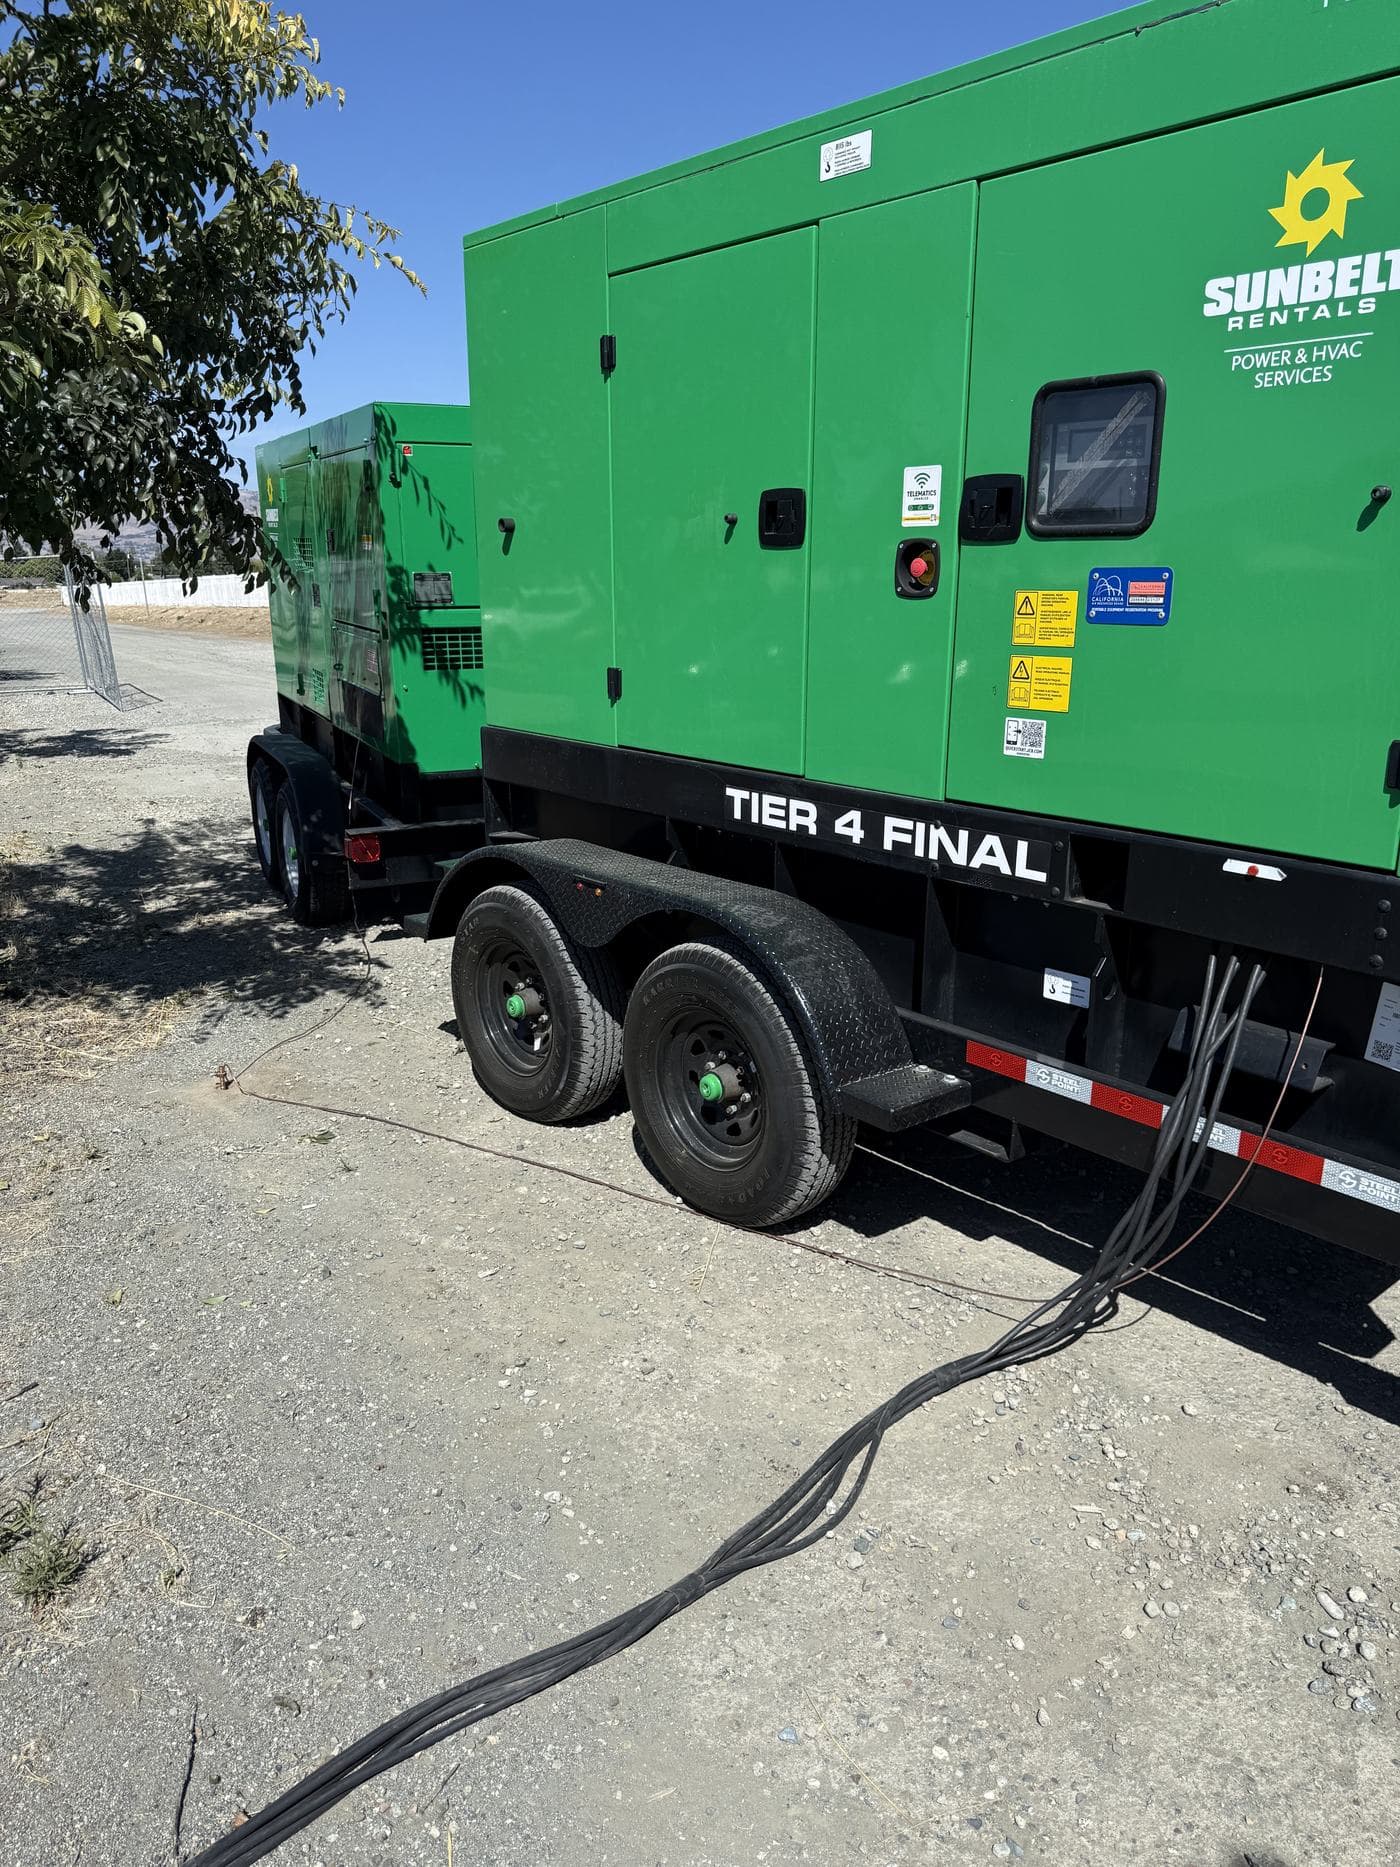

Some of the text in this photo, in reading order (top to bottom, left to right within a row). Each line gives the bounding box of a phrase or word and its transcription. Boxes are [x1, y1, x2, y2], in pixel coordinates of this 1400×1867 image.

[1203, 249, 1400, 317] SUNBELT
[1228, 298, 1376, 331] RENTALS
[1231, 341, 1363, 371] POWER & HVAC
[1254, 365, 1333, 388] SERVICES
[906, 489, 937, 498] TELEMATICS
[725, 786, 1047, 883] TIER 4 FINAL
[1051, 1079, 1080, 1093] POINT
[1052, 1073, 1081, 1087] STEEL
[1359, 1184, 1399, 1202] POINT
[1360, 1177, 1399, 1196] STEEL
